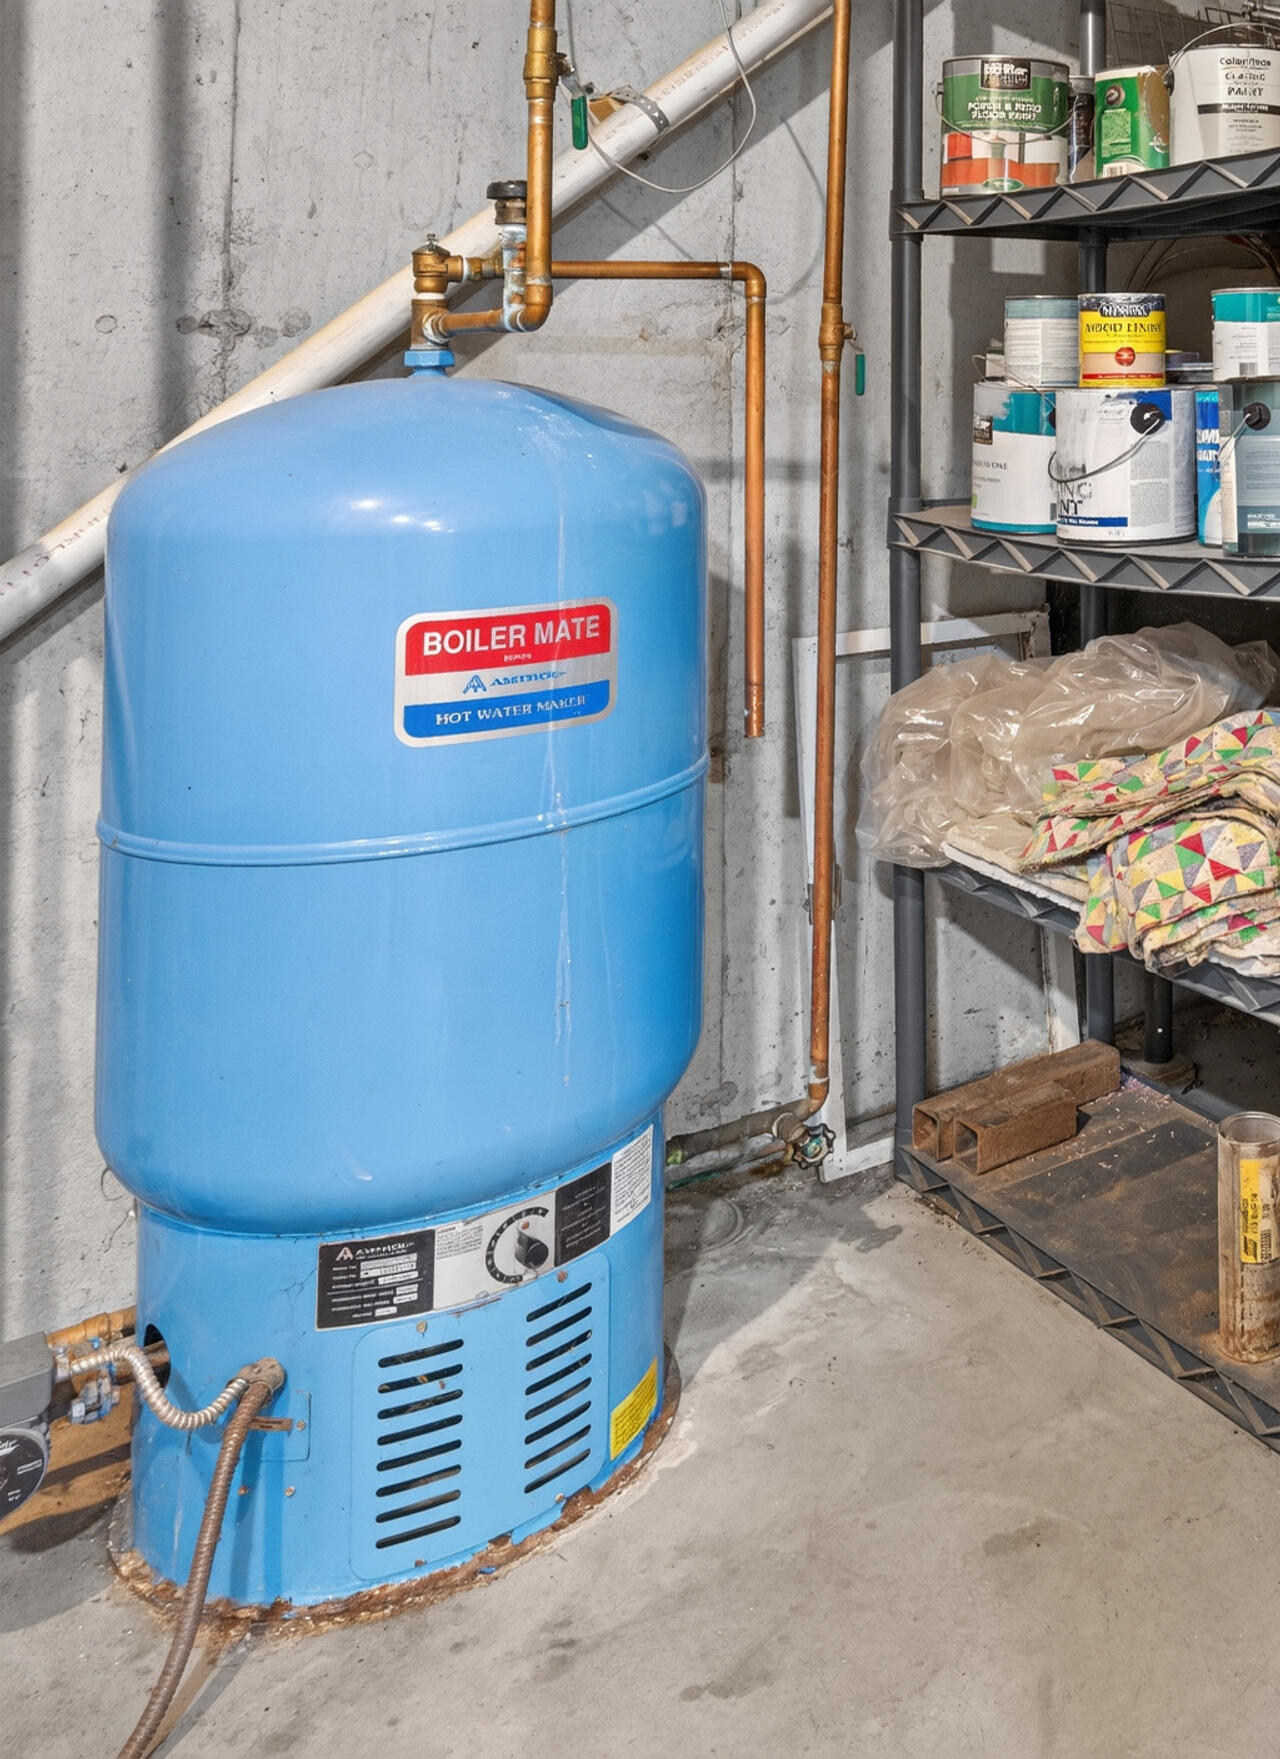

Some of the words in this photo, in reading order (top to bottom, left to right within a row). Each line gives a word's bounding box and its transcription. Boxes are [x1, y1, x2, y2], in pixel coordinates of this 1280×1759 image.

[423, 624, 526, 656] BOILER
[534, 615, 600, 646] MATE
[435, 710, 471, 726] HOT
[477, 703, 533, 721] WATER
[536, 695, 586, 712] MAKER
